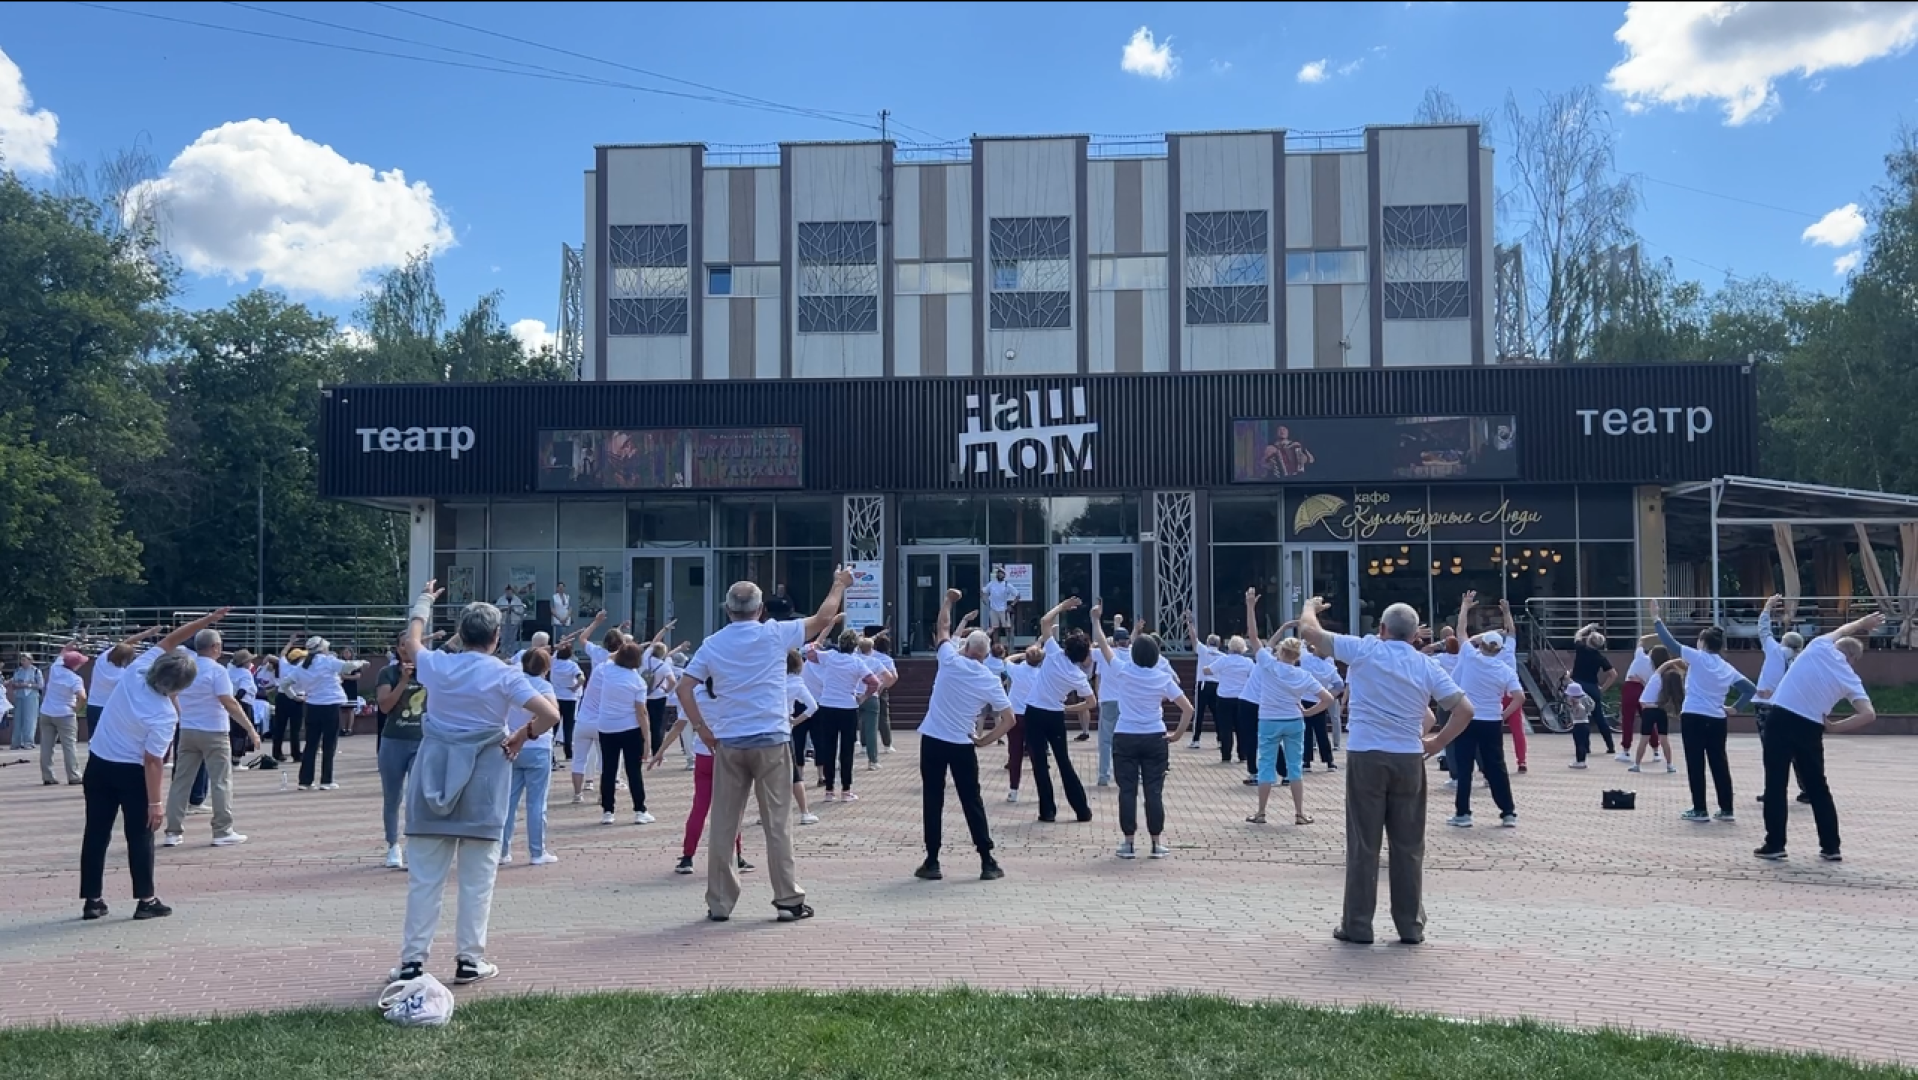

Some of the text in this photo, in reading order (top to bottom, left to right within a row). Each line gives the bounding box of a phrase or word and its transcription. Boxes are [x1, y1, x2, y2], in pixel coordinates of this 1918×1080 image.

[1575, 406, 1713, 442] театр
[355, 426, 476, 460] театр
[1354, 491, 1390, 505] кафе
[1342, 499, 1542, 538] Культурные Люди
